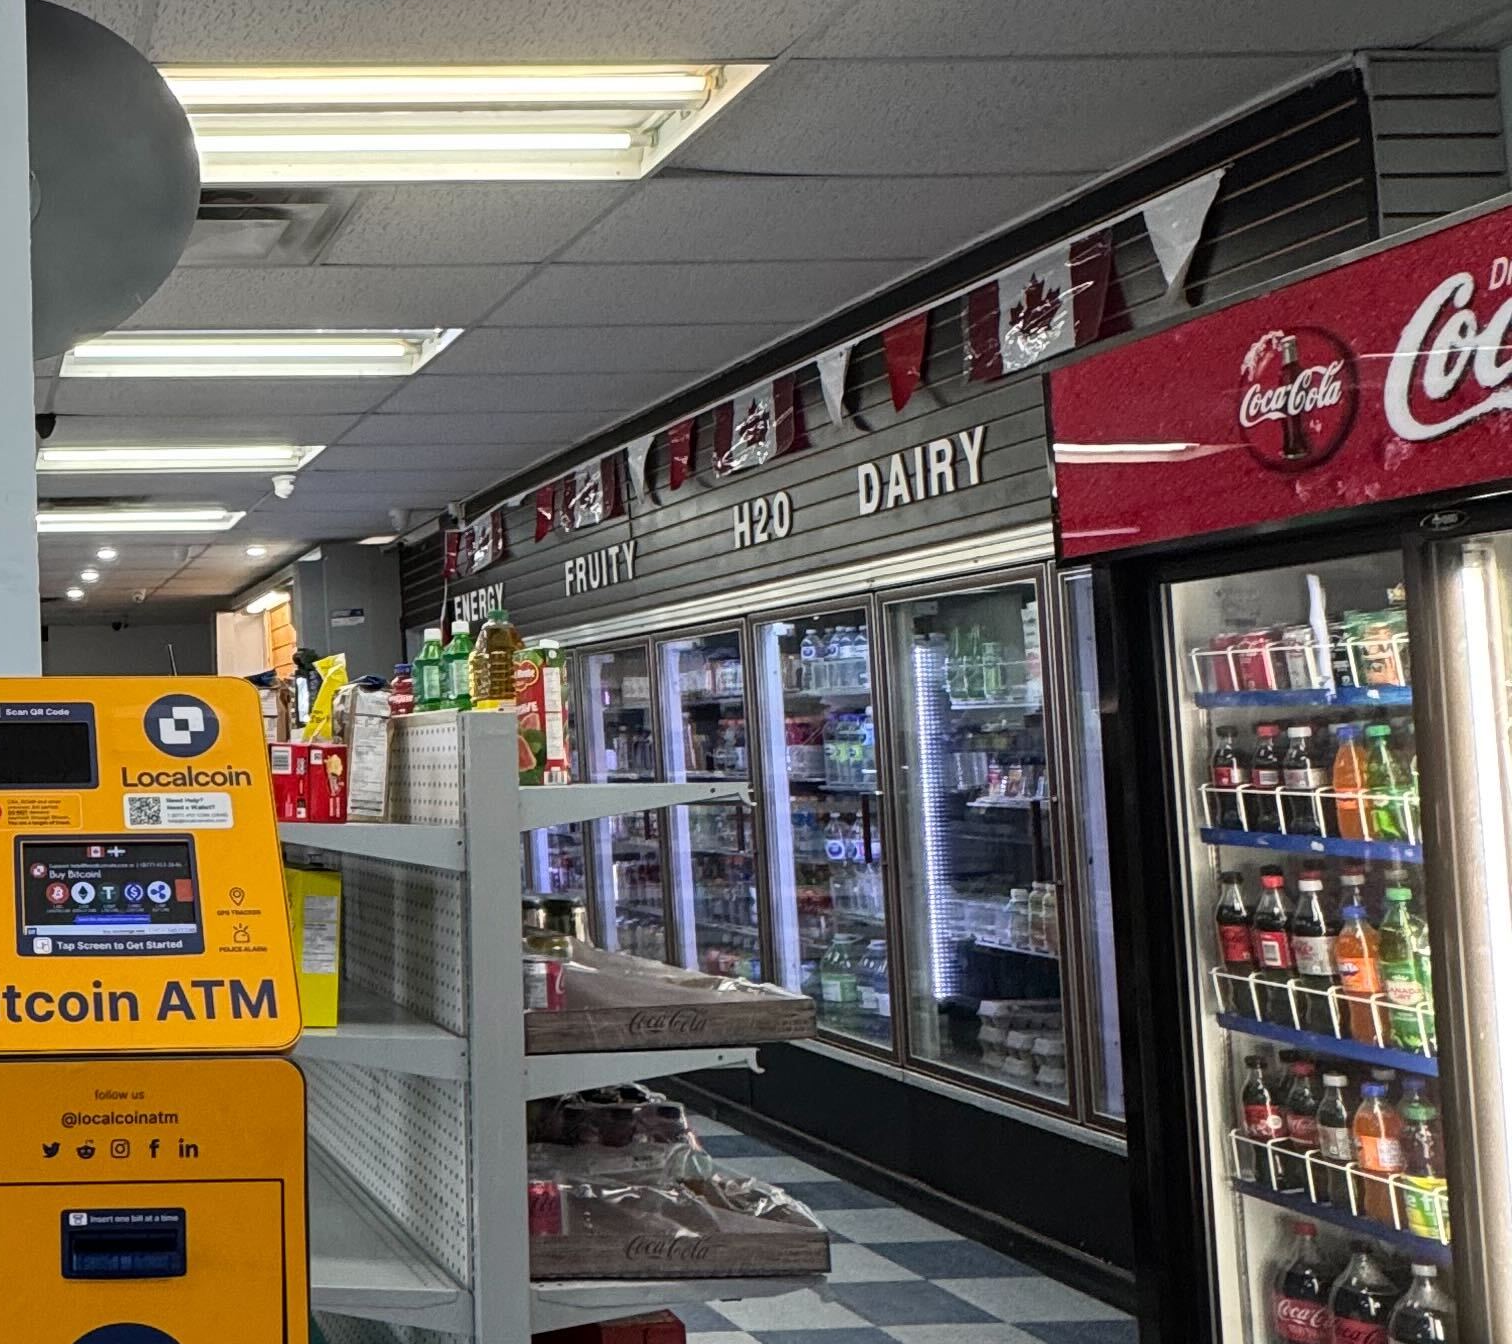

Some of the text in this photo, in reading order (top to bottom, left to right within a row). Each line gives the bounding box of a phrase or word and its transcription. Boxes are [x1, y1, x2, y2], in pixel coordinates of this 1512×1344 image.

[857, 424, 991, 517] DAIRY
[563, 539, 638, 597] FRUITY
[454, 582, 504, 622] ENERGY
[122, 765, 253, 788] Localcoin
[56, 939, 184, 951] Tap Screen to Get Started
[157, 979, 279, 1022] ATM
[94, 1088, 145, 1101] follow us
[60, 1109, 179, 1129] @localcoinatm
